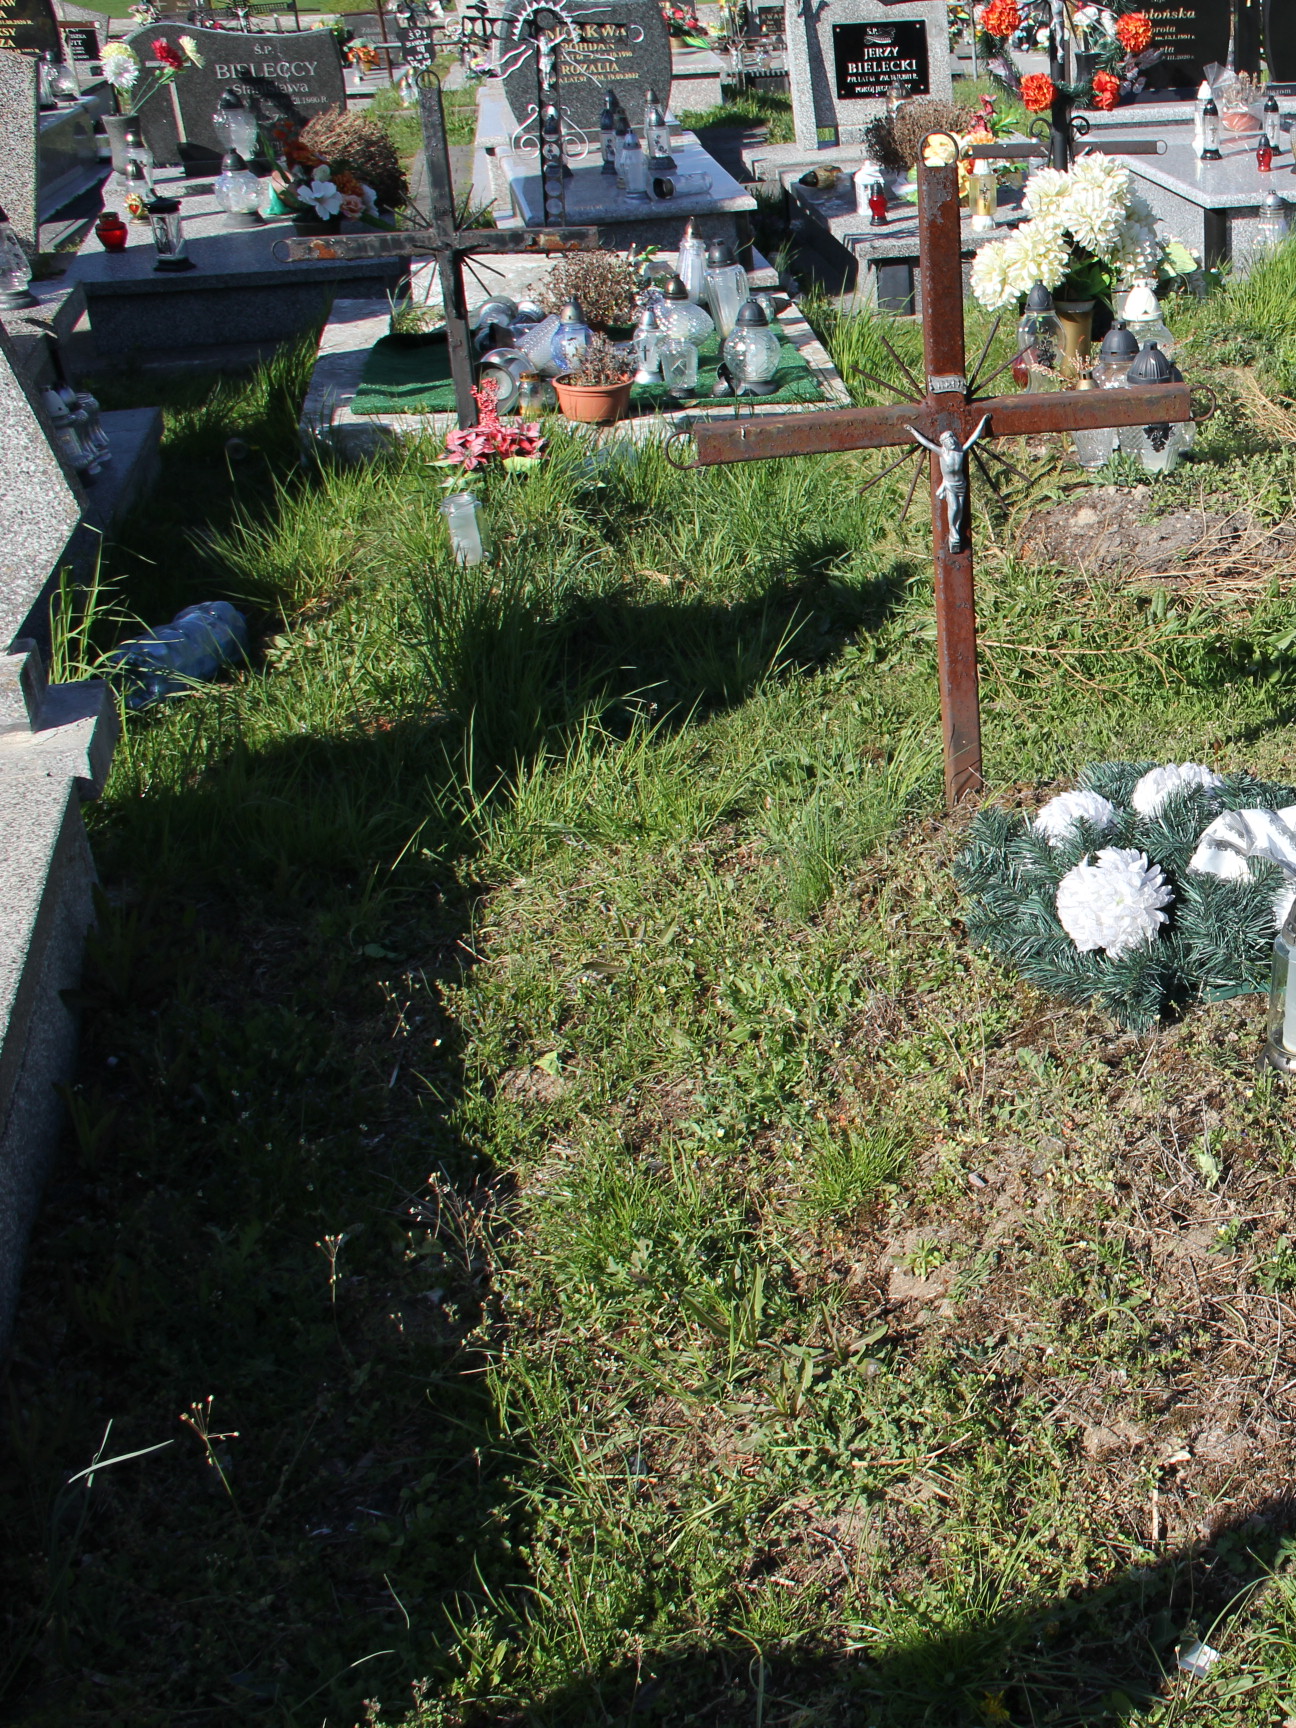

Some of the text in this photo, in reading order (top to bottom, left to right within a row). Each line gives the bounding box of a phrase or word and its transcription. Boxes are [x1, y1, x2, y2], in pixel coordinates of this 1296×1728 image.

[1151, 25, 1175, 33] orota
[864, 47, 898, 60] JERZY
[215, 61, 318, 79] BIELECCY
[561, 62, 619, 74] ROZALIA
[846, 60, 917, 74] BIELECKI
